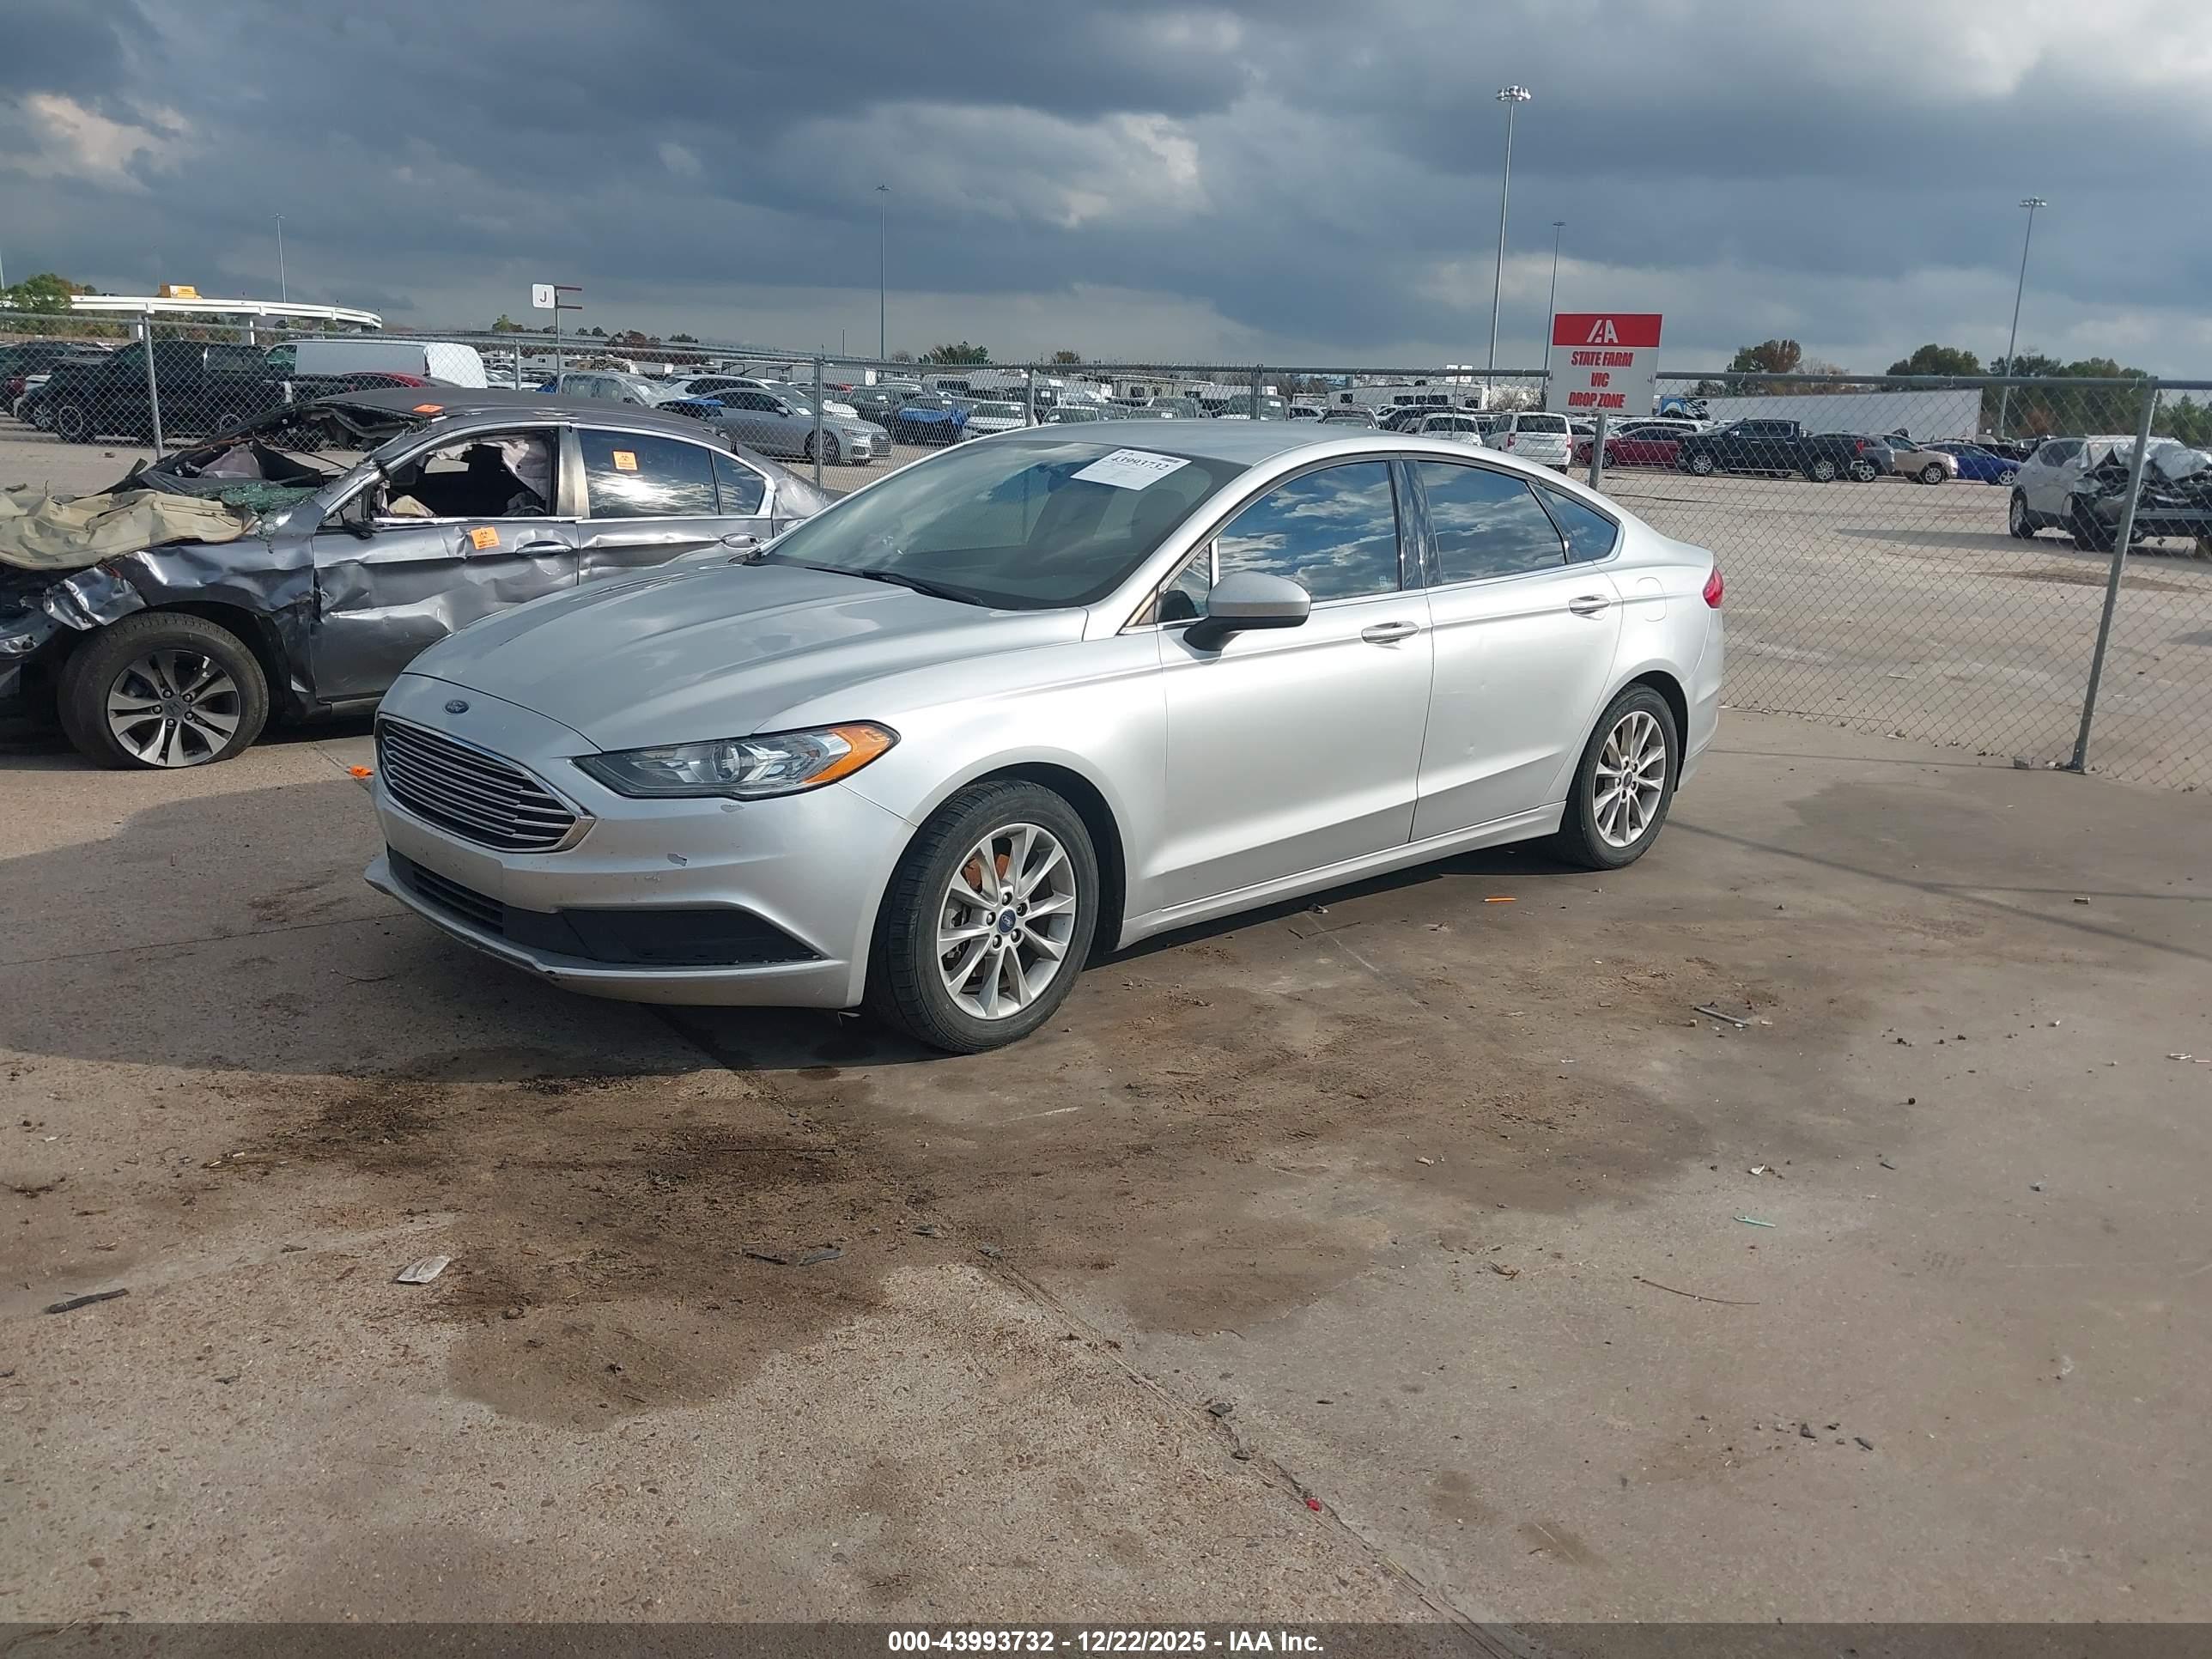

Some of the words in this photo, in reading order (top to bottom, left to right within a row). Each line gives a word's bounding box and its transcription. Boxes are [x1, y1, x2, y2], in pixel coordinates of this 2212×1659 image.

[539, 291, 547, 302] J
[1571, 351, 1601, 366] STATE
[1602, 352, 1634, 368] FARM
[1568, 392, 1597, 407] DROP
[1597, 392, 1626, 409] ZONE
[1111, 455, 1170, 471] 43993732
